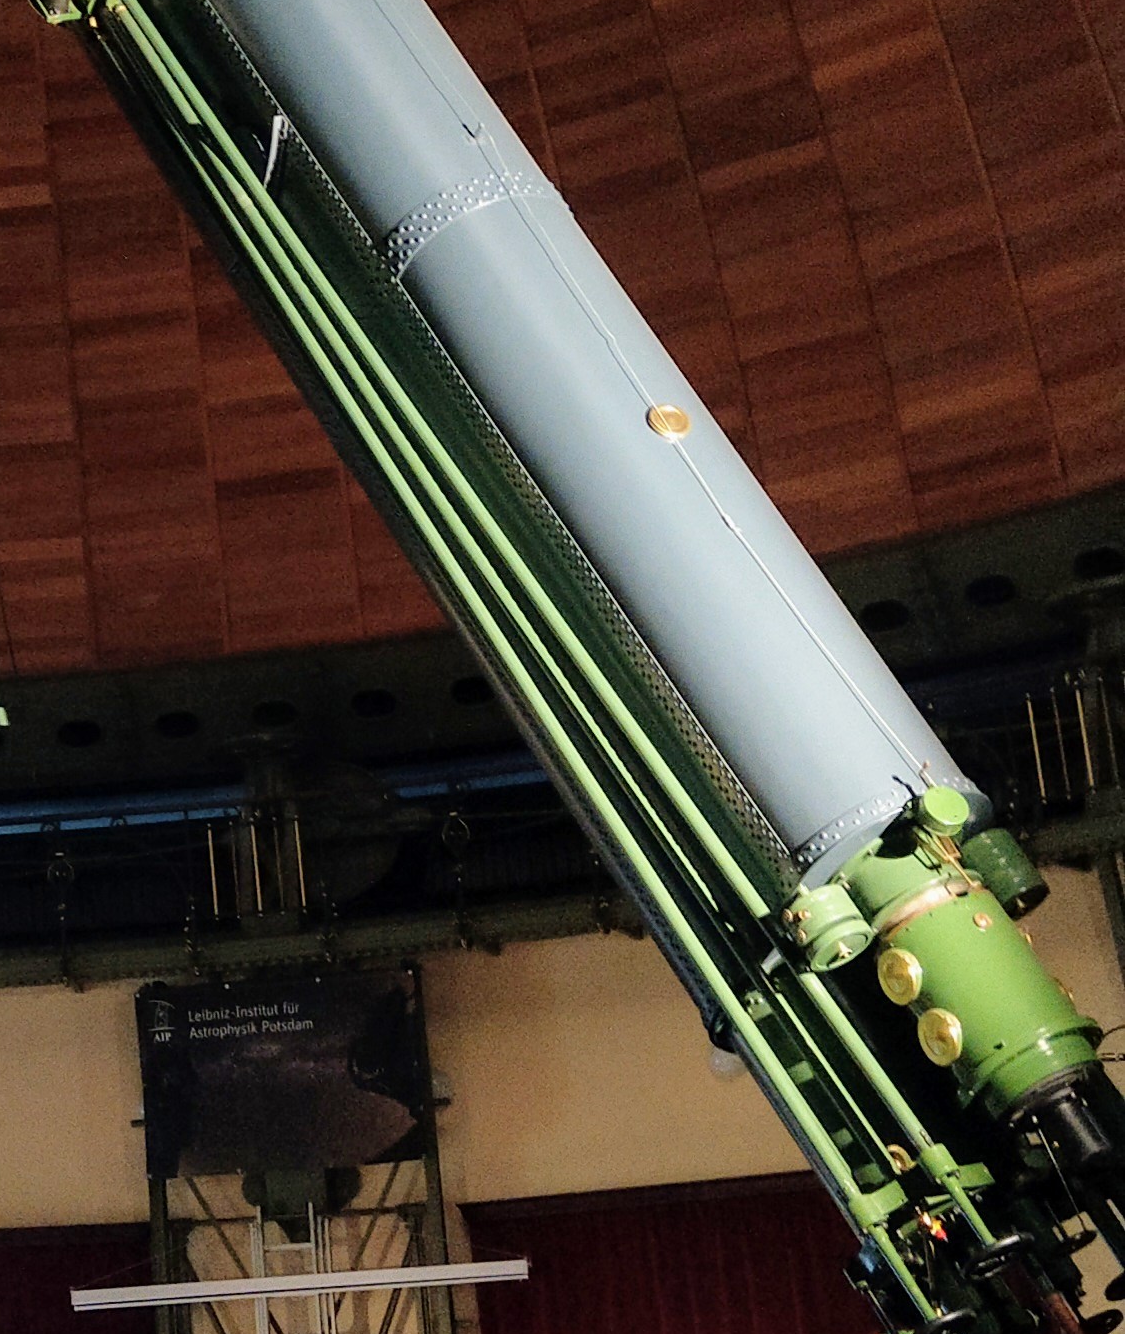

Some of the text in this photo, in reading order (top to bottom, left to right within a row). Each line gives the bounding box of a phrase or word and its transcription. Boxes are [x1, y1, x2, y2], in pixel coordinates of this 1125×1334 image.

[187, 1000, 300, 1023] Leibniz-Institut für
[153, 1031, 172, 1043] AIP
[188, 1018, 314, 1040] Astrophysik Potsdam
